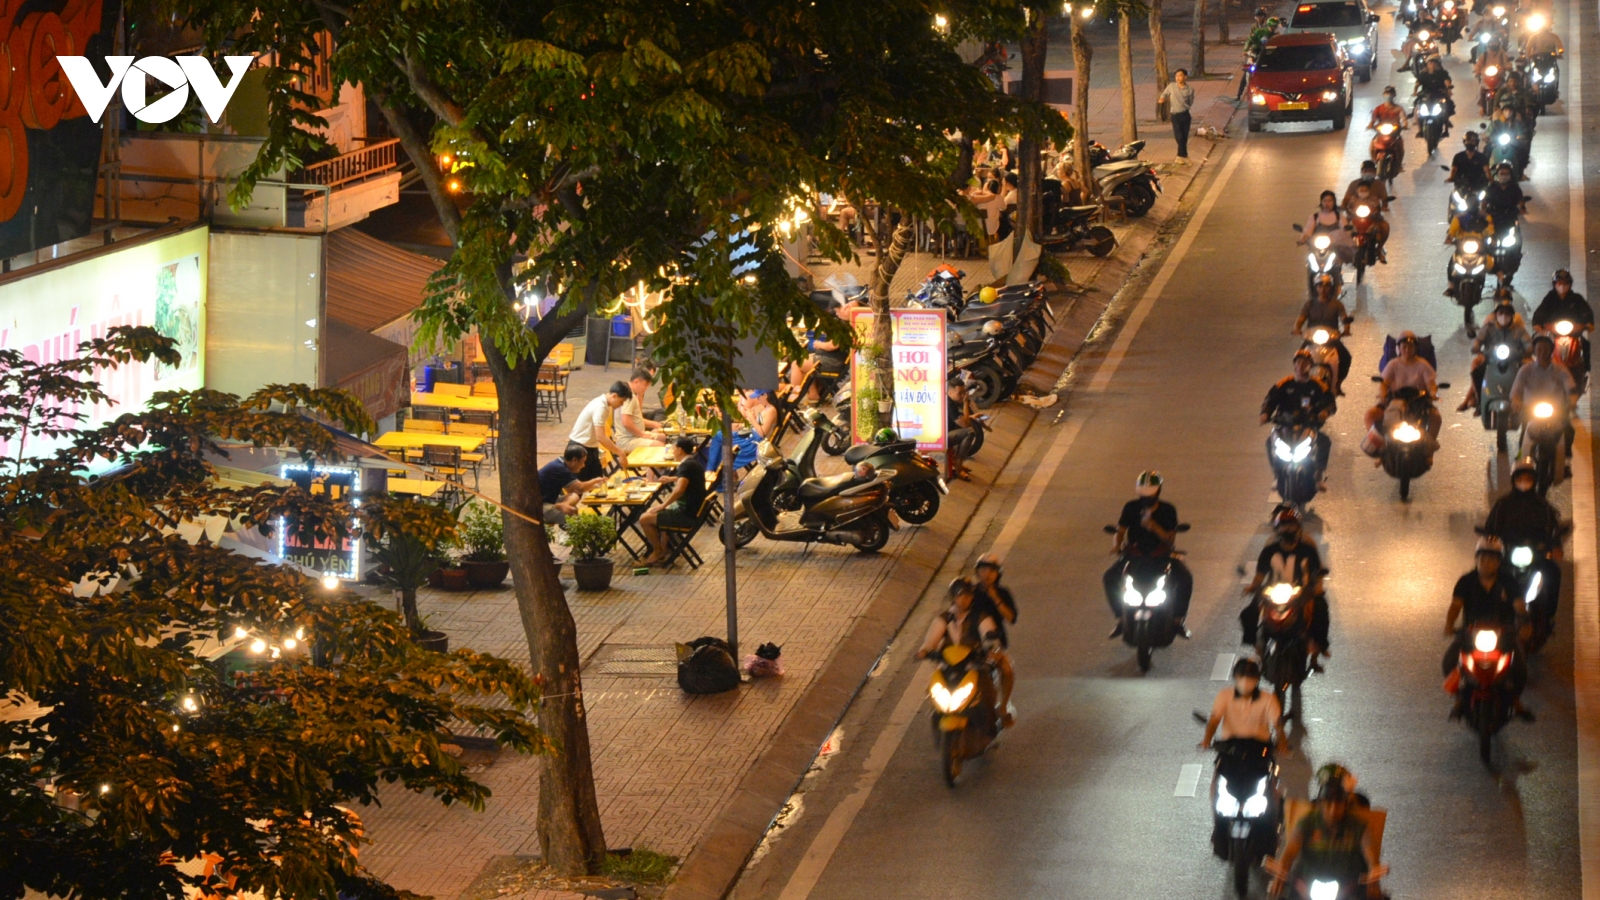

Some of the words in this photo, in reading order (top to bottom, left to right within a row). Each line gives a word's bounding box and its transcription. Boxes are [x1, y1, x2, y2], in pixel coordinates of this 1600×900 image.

[898, 351, 930, 364] HƠI
[897, 366, 929, 385] NỘI
[285, 552, 315, 569] PHÚ
[319, 554, 351, 572] YÊN
